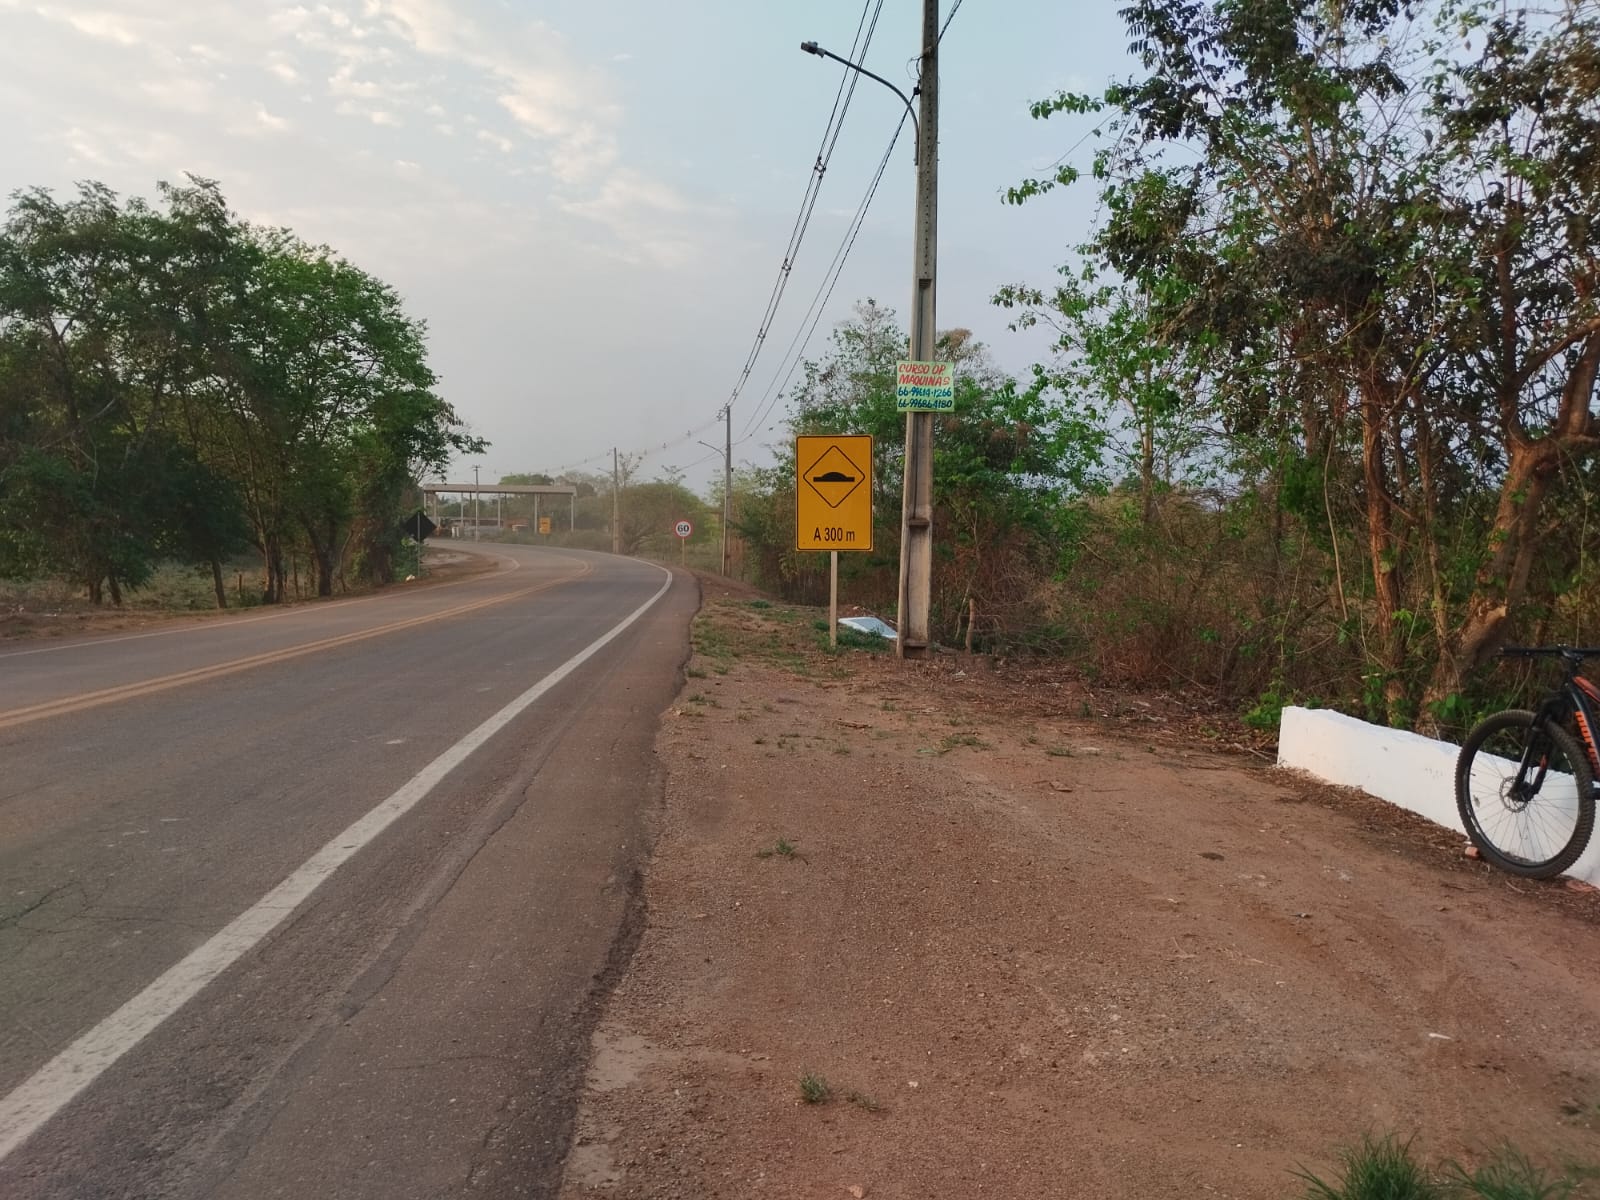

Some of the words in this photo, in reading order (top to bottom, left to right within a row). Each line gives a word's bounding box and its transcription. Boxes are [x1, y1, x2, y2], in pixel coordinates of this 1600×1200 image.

[898, 363, 930, 374] CURSO
[898, 374, 951, 387] MAQUINAS
[677, 524, 690, 532] 60
[813, 527, 821, 541] A
[824, 527, 843, 541] 300
[846, 531, 855, 541] m
